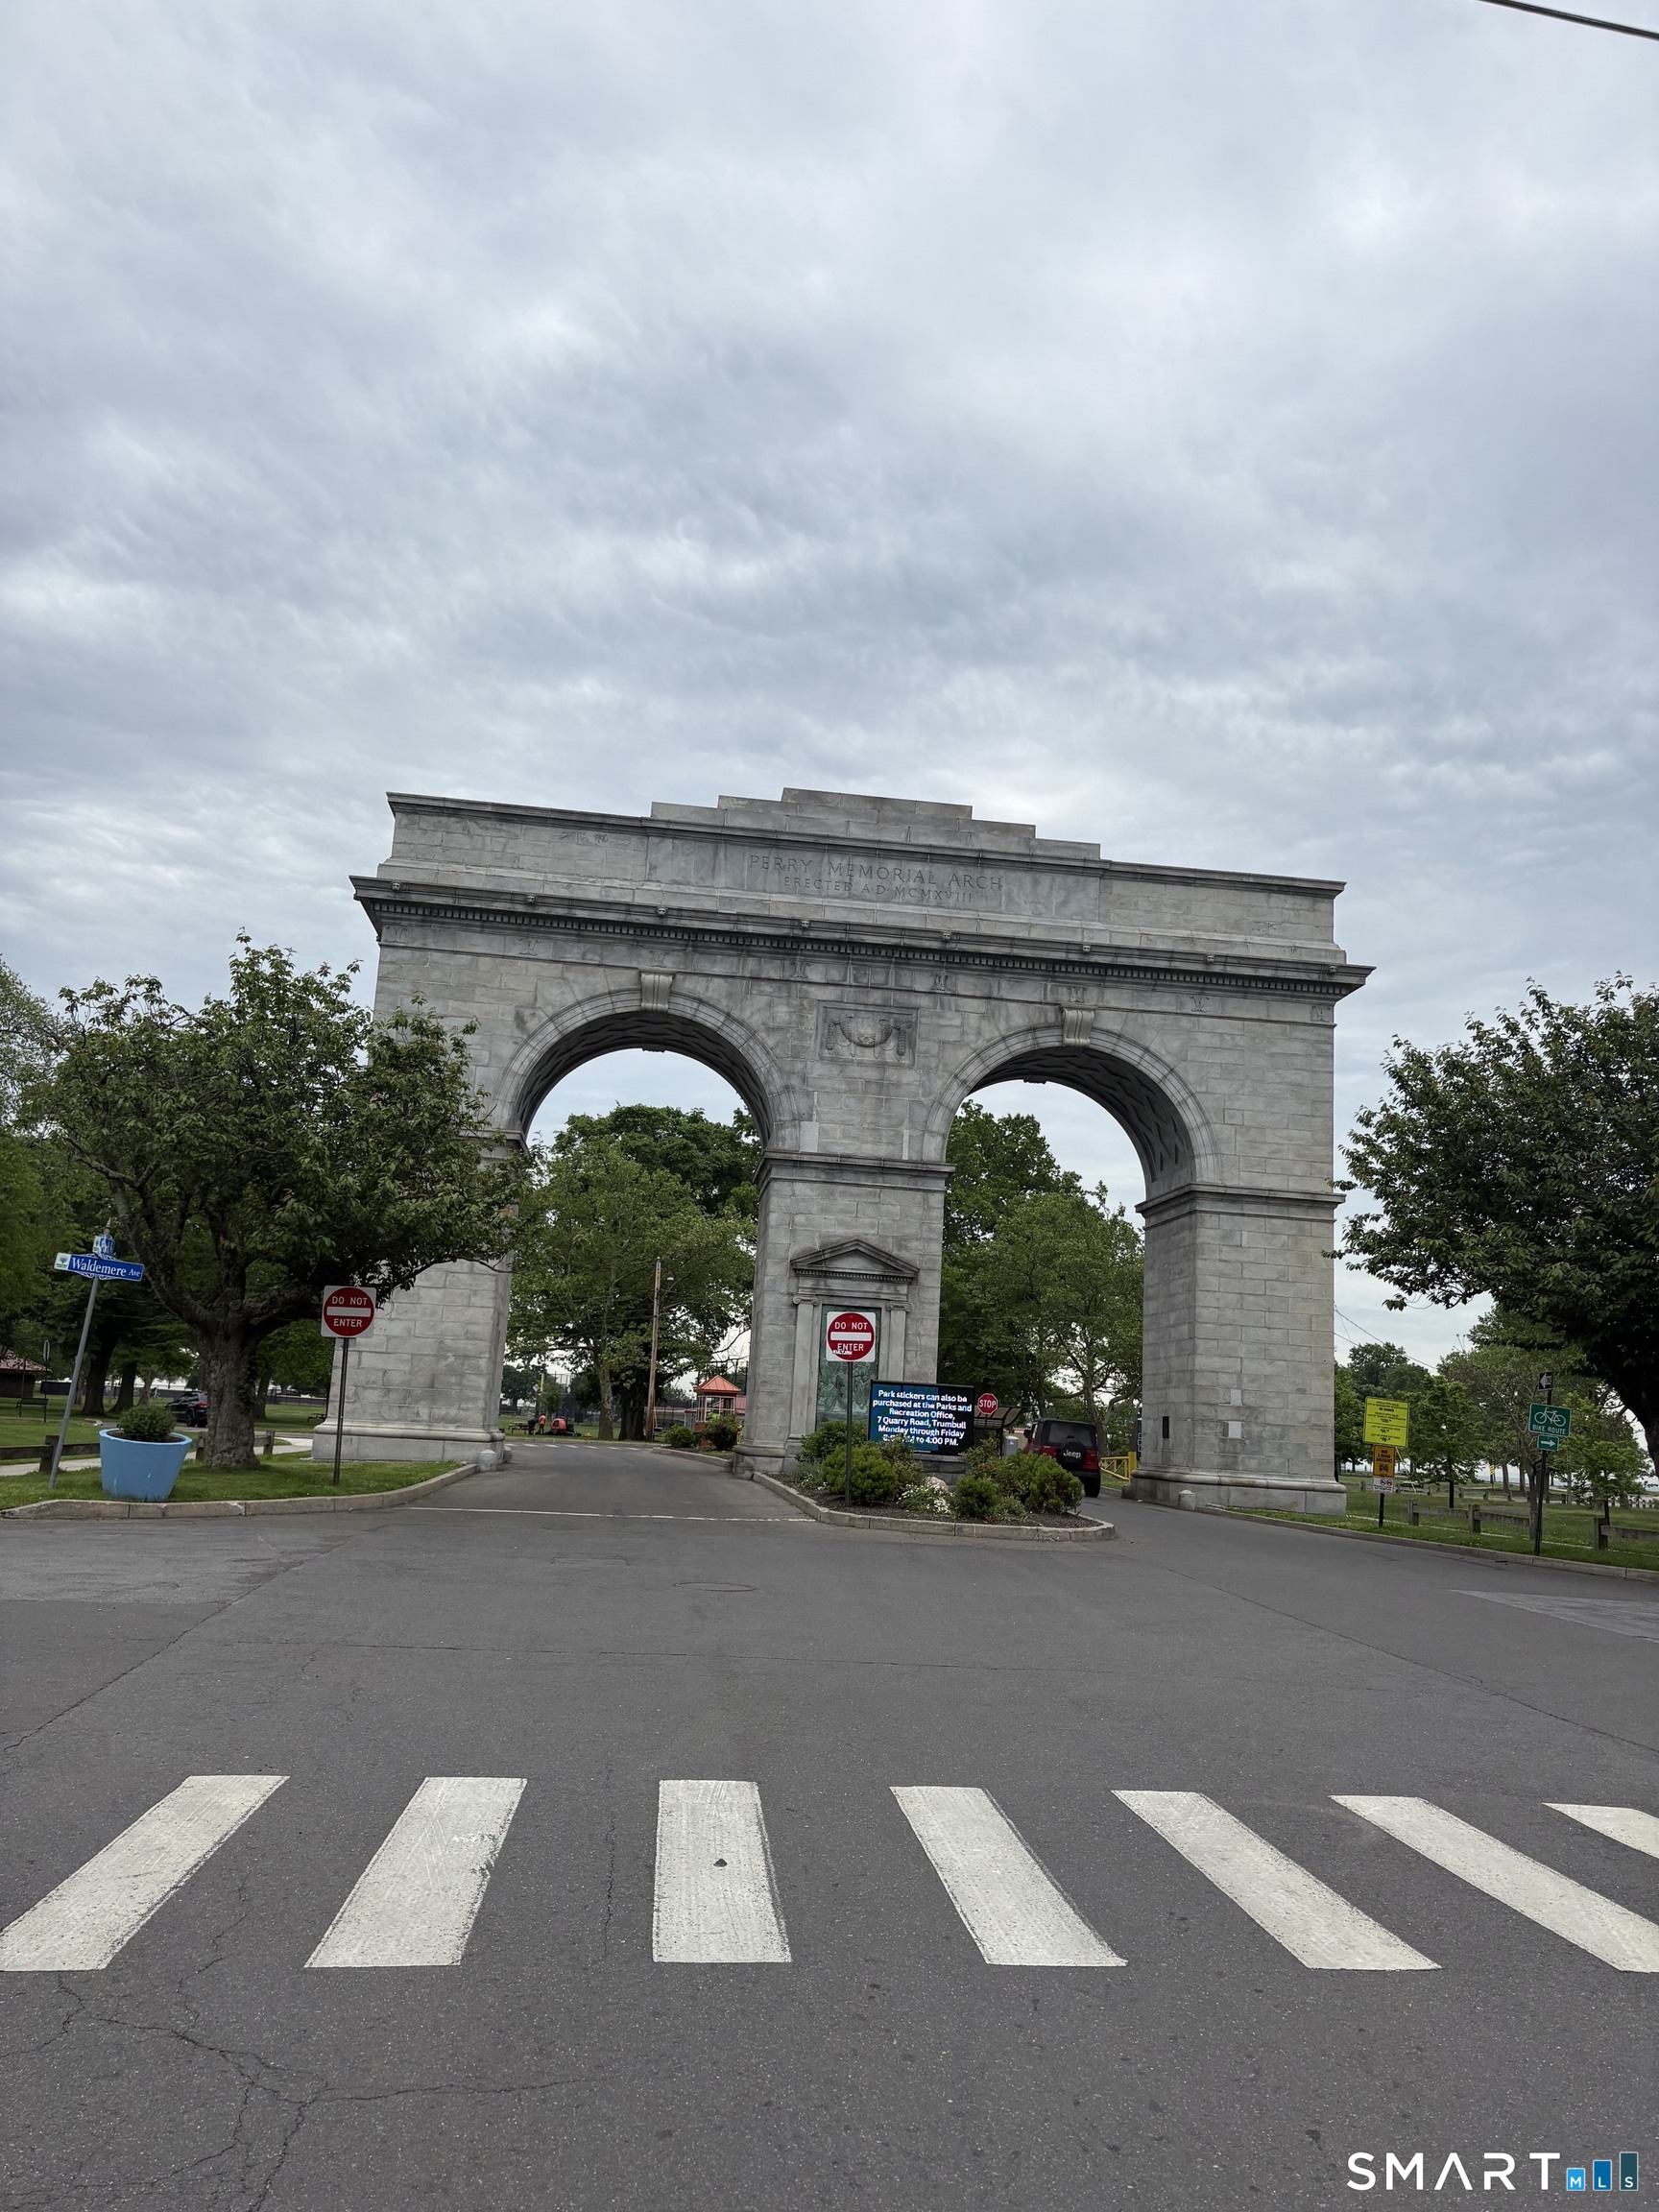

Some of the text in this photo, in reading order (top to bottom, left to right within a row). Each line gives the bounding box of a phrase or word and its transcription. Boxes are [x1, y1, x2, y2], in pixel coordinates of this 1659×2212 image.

[750, 854, 1001, 891] PERRY MEMORIAL ARCH
[784, 877, 854, 892] ERECTED
[895, 885, 972, 902] MCMXVIII
[72, 1257, 141, 1278] Waldemere Ave
[331, 1296, 368, 1306] DO NOT
[333, 1318, 363, 1327] ENTER
[834, 1321, 868, 1330] DO NOT
[878, 1389, 895, 1398] Park
[897, 1391, 926, 1401] stickers
[941, 1394, 956, 1403] also
[873, 1400, 912, 1408] purchased
[936, 1403, 956, 1411] Parks
[978, 1399, 997, 1409] STOP
[889, 1408, 955, 1421] Recreation Office,
[882, 1416, 908, 1427] Quarry
[909, 1418, 931, 1428] Road,
[932, 1420, 967, 1430] Trumbull
[878, 1425, 965, 1439] Monday through Friday
[1532, 1424, 1566, 1434] BIKE ROUTE
[926, 1436, 943, 1445] 4:00
[945, 1437, 959, 1446] PM.
[1063, 1450, 1081, 1459] Jeep
